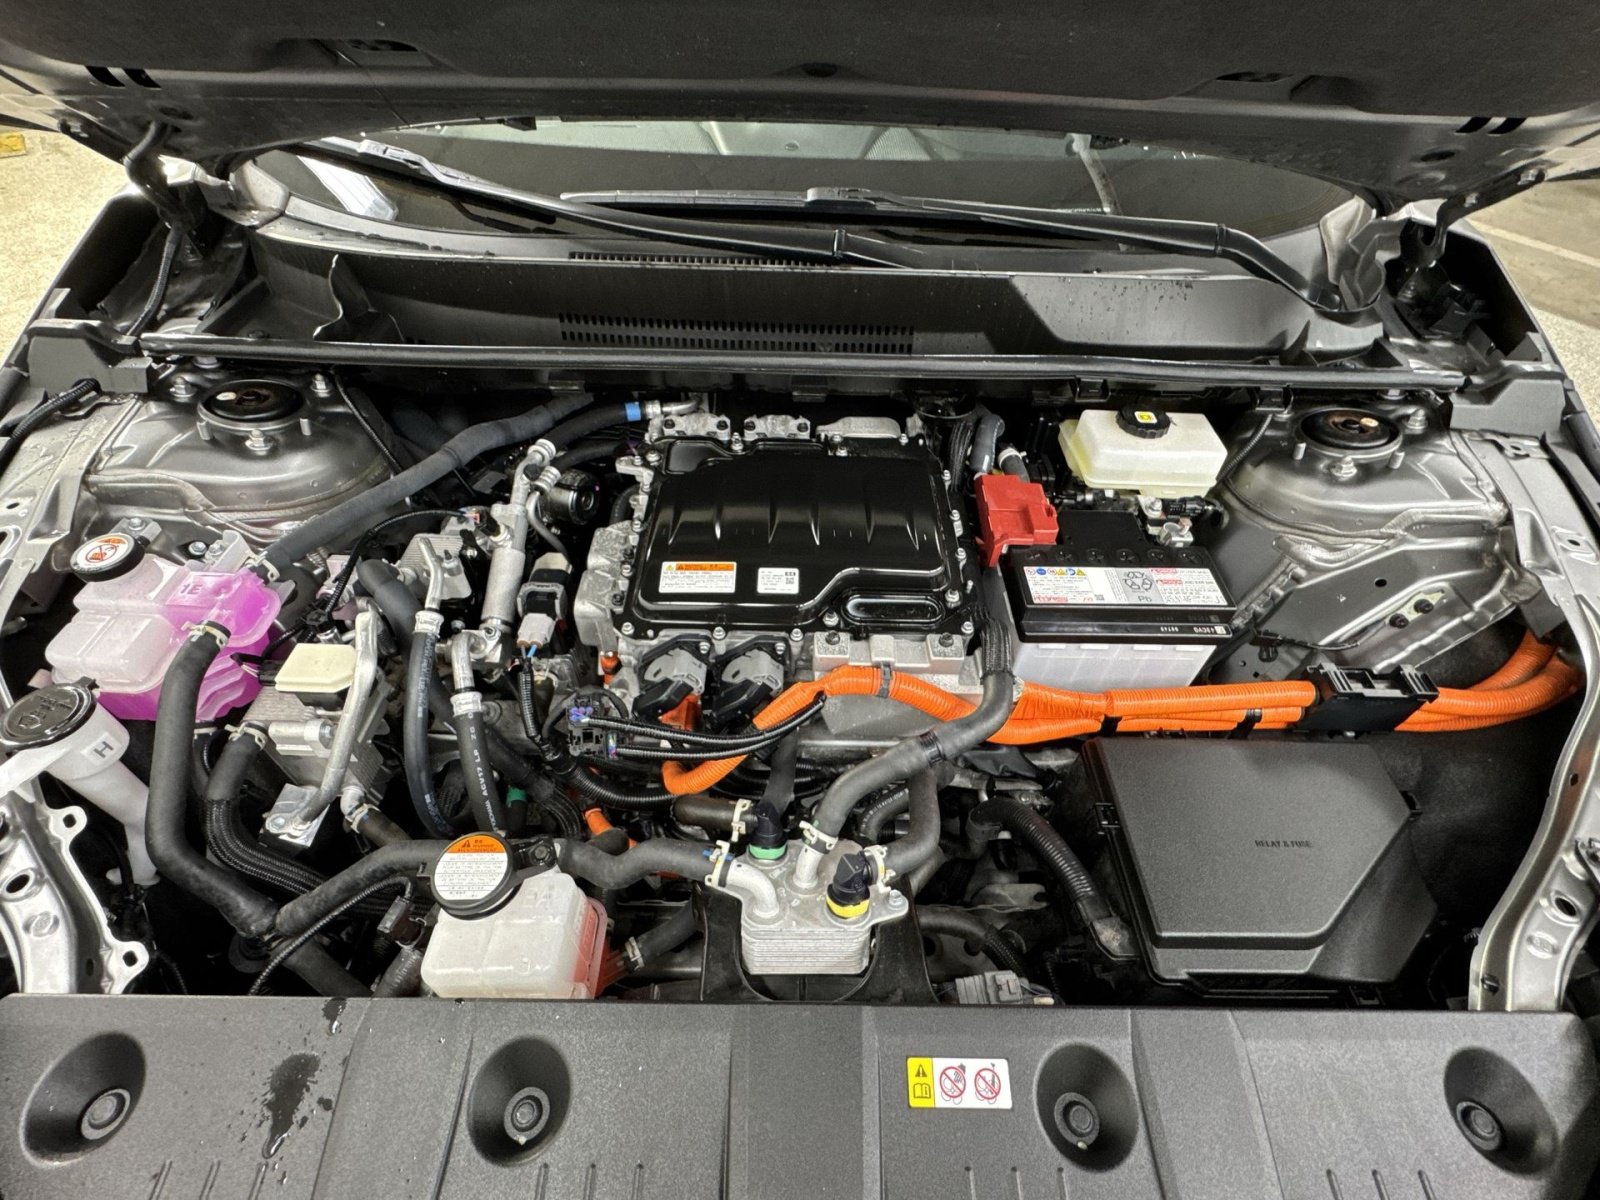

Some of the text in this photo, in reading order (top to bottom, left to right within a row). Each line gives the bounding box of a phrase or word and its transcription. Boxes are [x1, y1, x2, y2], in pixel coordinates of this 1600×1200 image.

[93, 741, 114, 758] H
[1254, 840, 1281, 848] RELAY
[1290, 840, 1311, 848] FUSE
